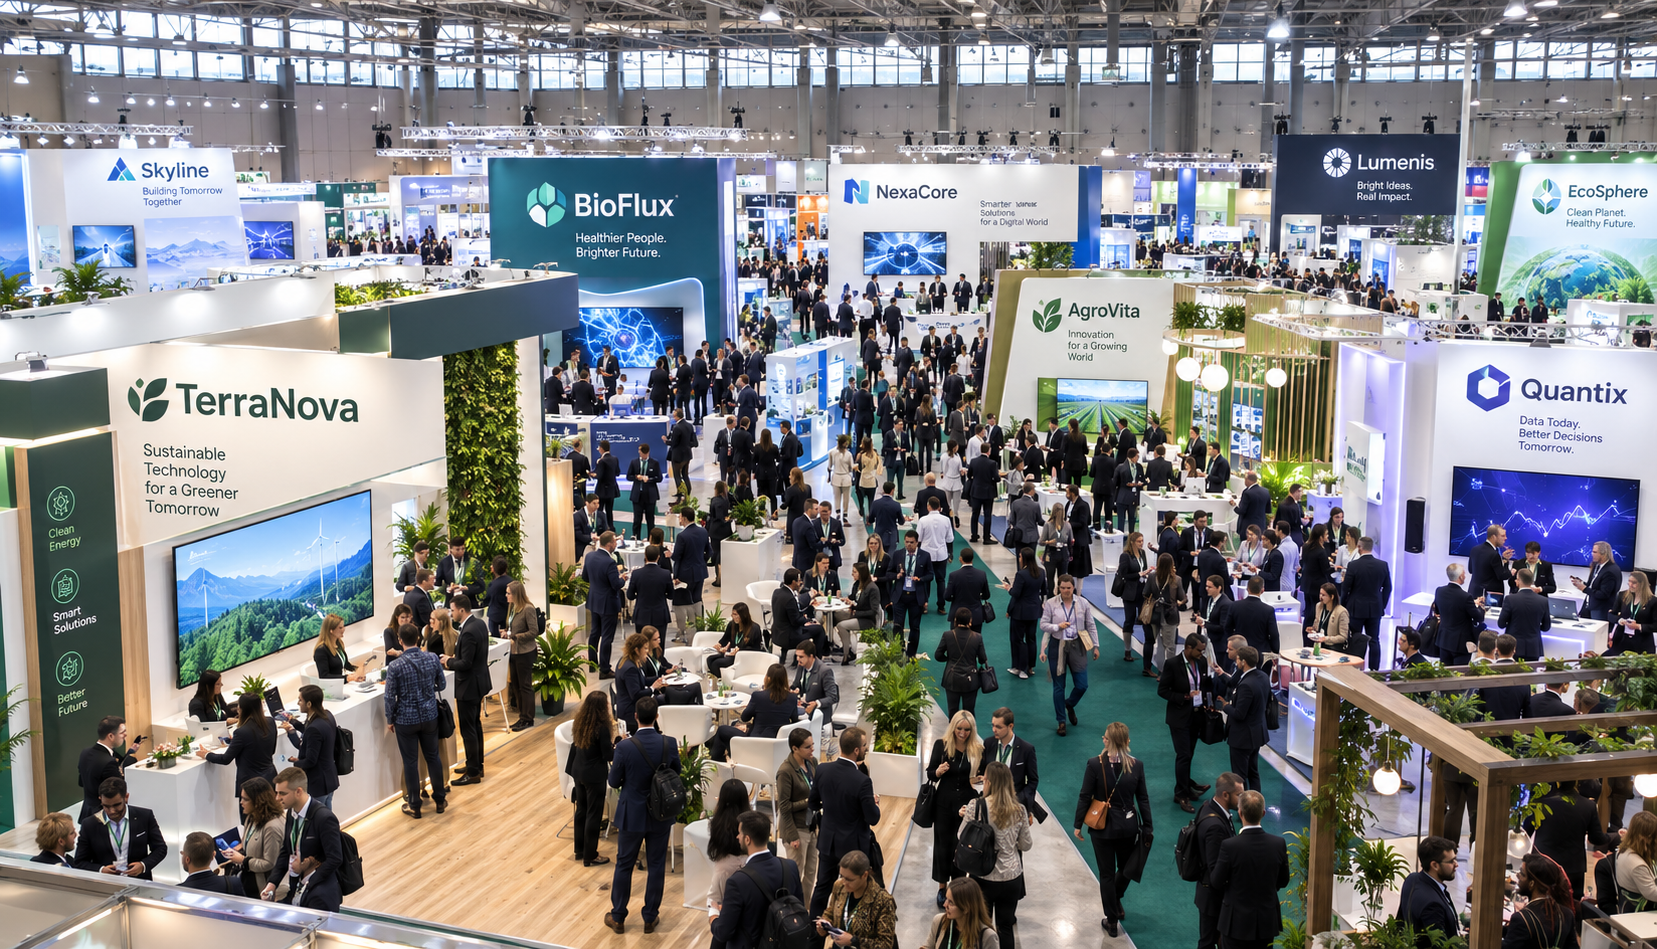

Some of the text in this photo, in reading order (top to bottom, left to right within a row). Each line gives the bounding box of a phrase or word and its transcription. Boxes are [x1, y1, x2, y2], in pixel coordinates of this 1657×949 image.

[1358, 154, 1434, 170] Lumenis
[142, 162, 209, 182] Skyline
[143, 187, 223, 197] Building Tomorrow
[877, 185, 957, 199] NexaCore
[1358, 181, 1412, 191] Bright Ideas.
[1569, 185, 1648, 200] EcoSphere
[143, 198, 182, 208] Together
[575, 193, 674, 216] BioFlux
[980, 200, 1011, 208] Smarter
[1357, 192, 1412, 202] Real Impact.
[1567, 208, 1626, 216] Clean Planet.
[1566, 219, 1636, 229] Healthy Future.
[576, 233, 667, 245] Healthier People.
[577, 247, 661, 259] Brighter Future.
[1068, 302, 1140, 321] AgroVita
[1069, 330, 1114, 339] Innovation
[1068, 341, 1080, 349] for
[1091, 342, 1127, 352] Growing
[1068, 353, 1093, 361] World
[1521, 378, 1628, 404] Quantix
[176, 383, 358, 422] TerraNova
[1520, 416, 1580, 430] Data Today.
[1519, 428, 1602, 443] Better Decisions
[144, 443, 225, 461] Sustainable
[1519, 441, 1574, 454] Tomorrow.
[145, 462, 226, 483] Technology
[145, 481, 238, 499] for a Greener
[146, 500, 219, 517] Tomorrow
[49, 526, 75, 539] Clean
[49, 535, 81, 551] Energy
[53, 606, 82, 622] Smart
[54, 613, 97, 634] Solutions
[58, 689, 85, 704] Better
[58, 699, 87, 716] Future
